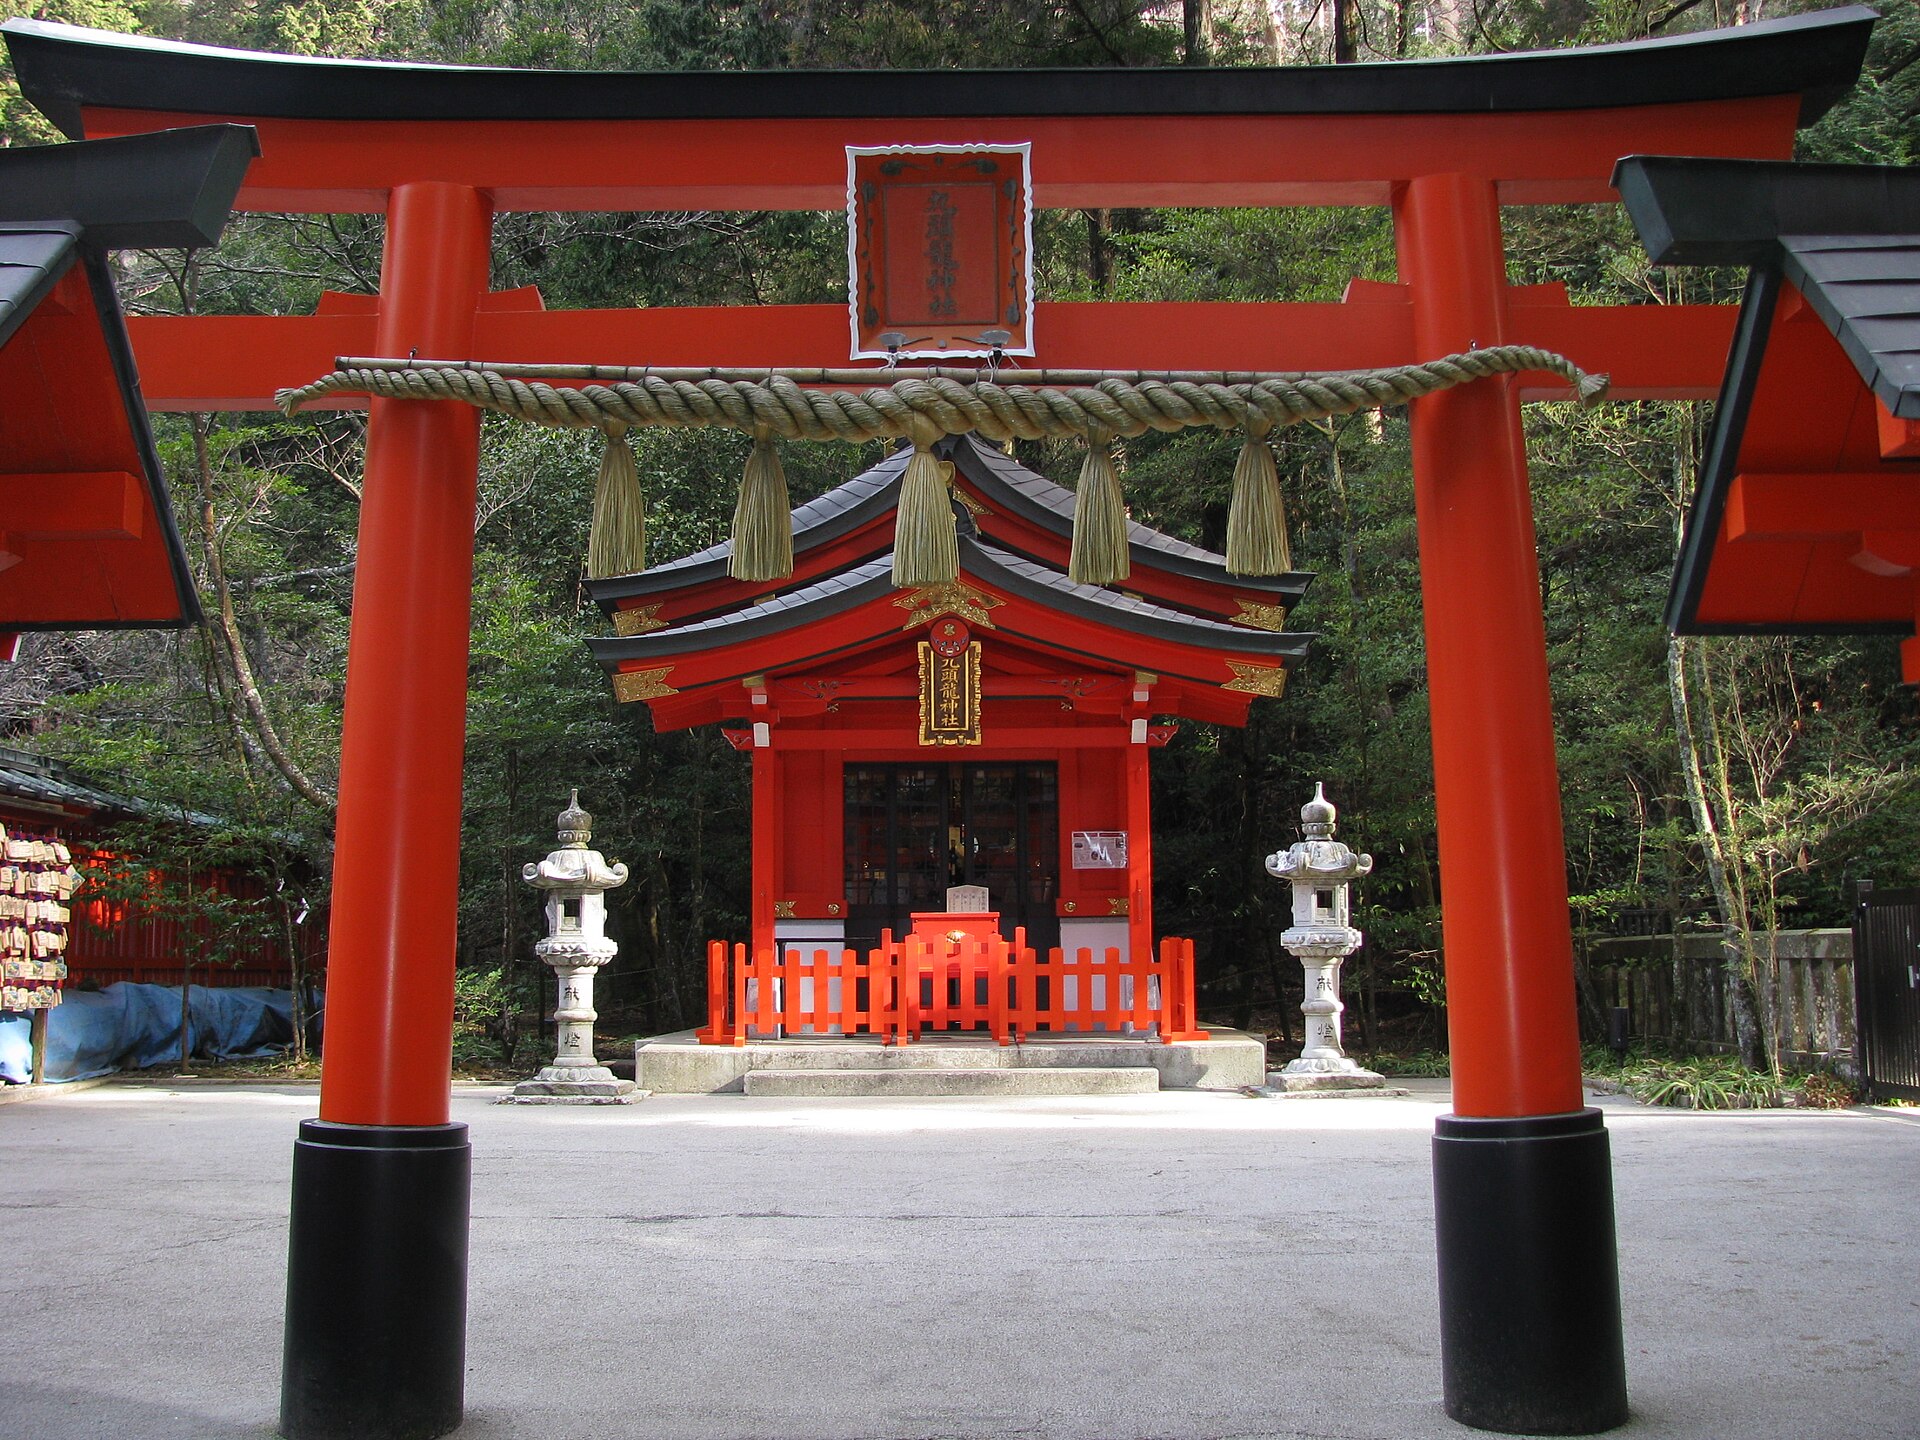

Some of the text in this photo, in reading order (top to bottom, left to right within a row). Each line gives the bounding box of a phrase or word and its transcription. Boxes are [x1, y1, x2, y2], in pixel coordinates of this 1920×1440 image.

[923, 190, 960, 316] 九頭龍神社
[940, 659, 960, 727] 九頭龍神社
